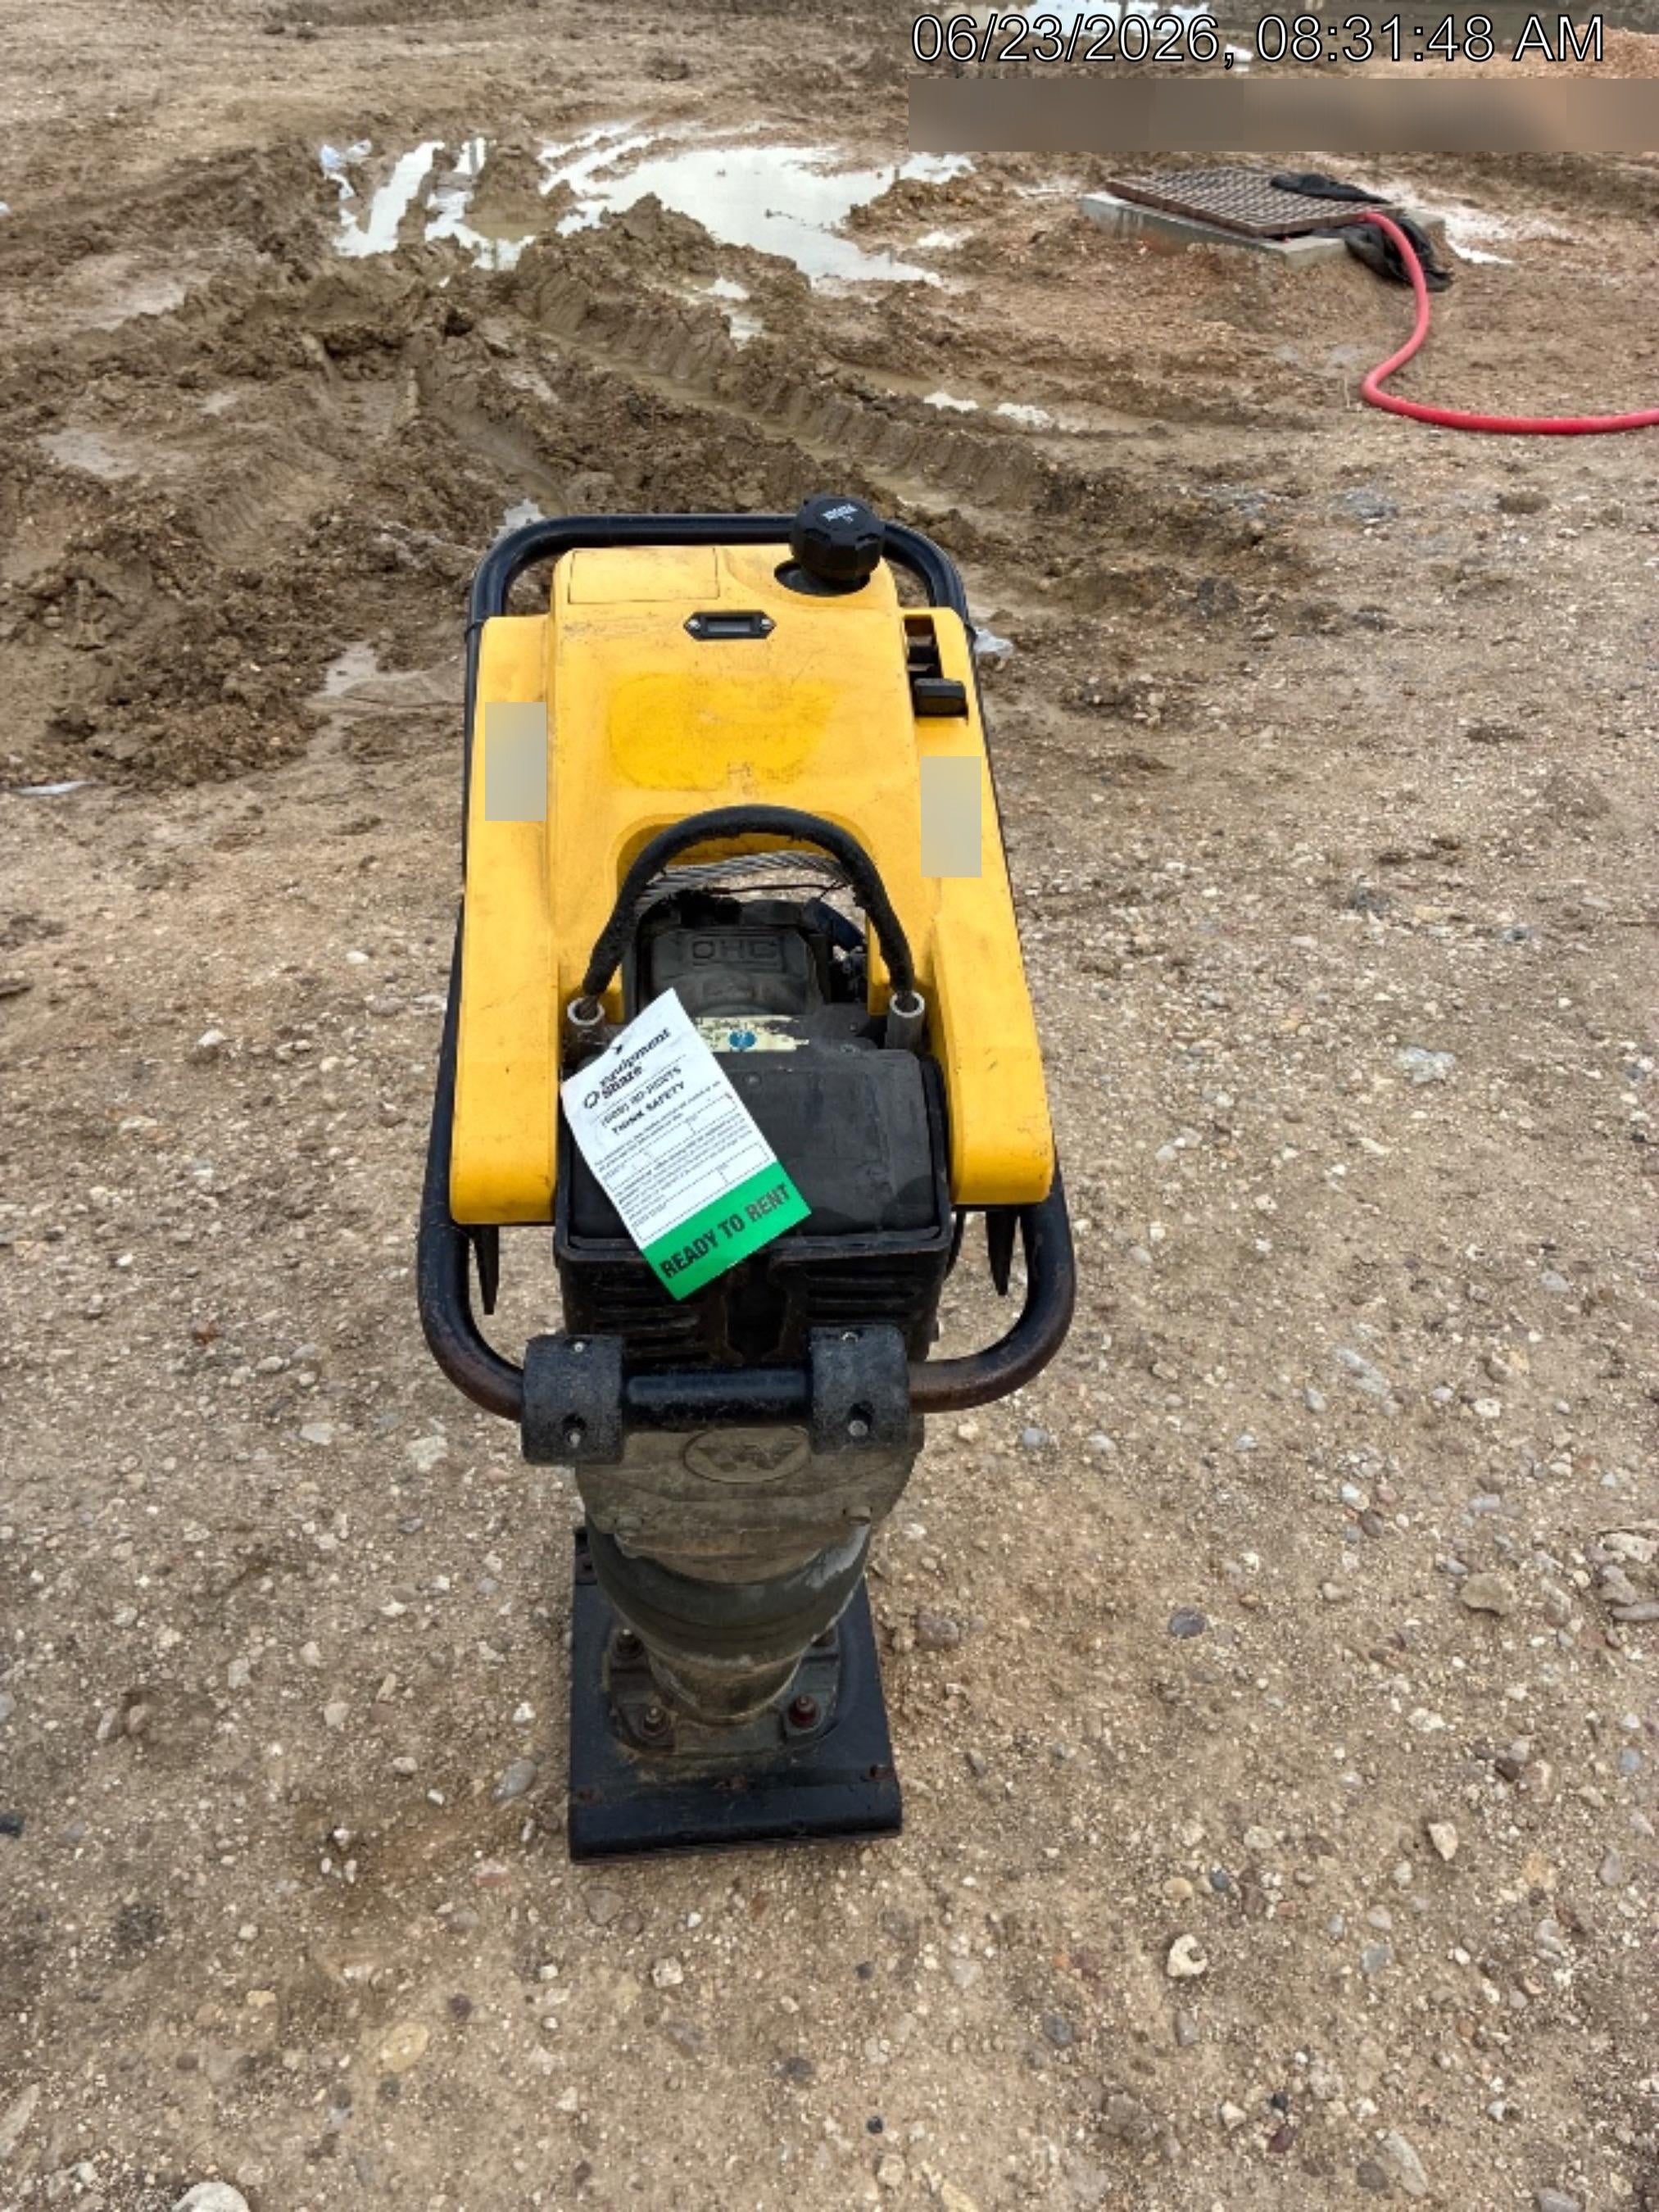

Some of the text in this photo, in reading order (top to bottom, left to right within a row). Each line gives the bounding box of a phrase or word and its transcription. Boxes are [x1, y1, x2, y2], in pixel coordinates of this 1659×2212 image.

[611, 1081, 685, 1135] THINK SAFETY
[659, 1228, 719, 1279] READY
[718, 1213, 746, 1240] TO
[745, 1181, 791, 1223] RENT
